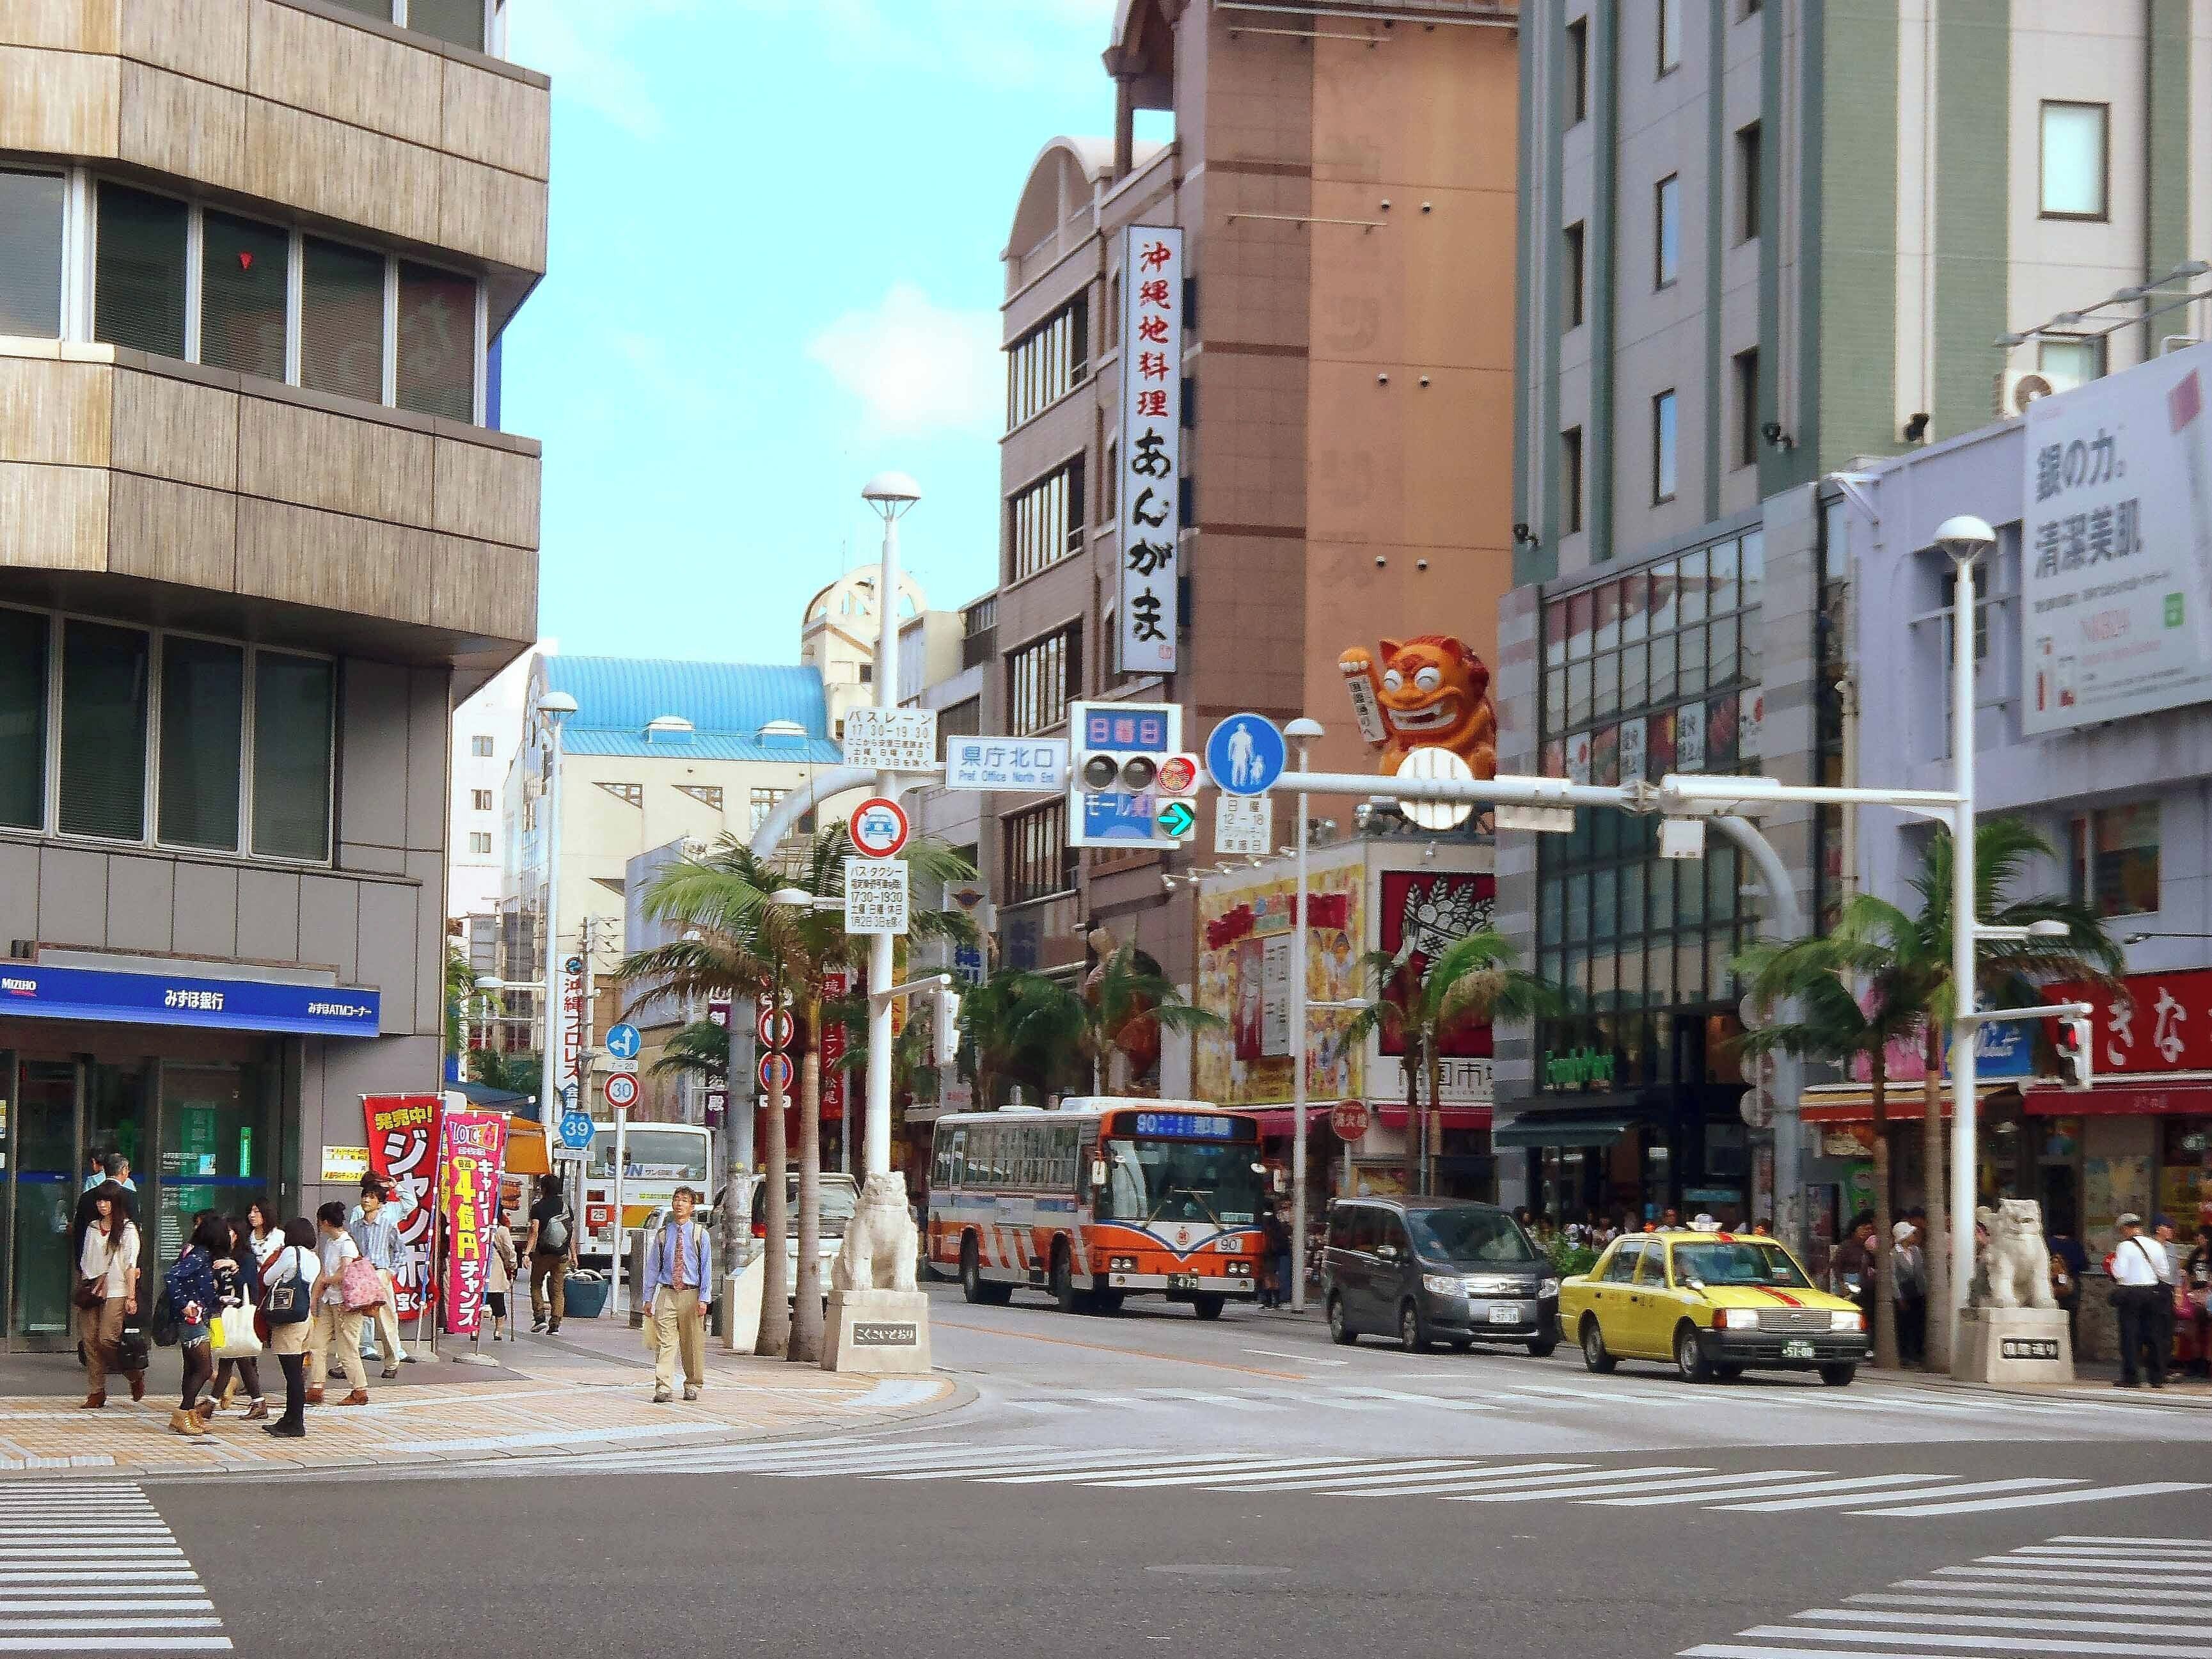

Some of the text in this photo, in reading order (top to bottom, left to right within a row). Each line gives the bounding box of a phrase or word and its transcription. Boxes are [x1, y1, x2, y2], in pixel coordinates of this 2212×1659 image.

[1126, 427, 1173, 642] あんがま
[849, 711, 931, 725] バスレーン
[961, 746, 1054, 768] 県庁北口
[1, 978, 36, 990] MIZUHO
[164, 989, 224, 1011] みずほ銀行
[308, 1002, 372, 1017] みずほATMコーナー
[613, 1083, 632, 1098] 30
[565, 1121, 589, 1137] 39
[593, 1210, 605, 1220] 25
[1221, 1238, 1237, 1250] 90
[856, 1328, 914, 1340] こくさいどおり
